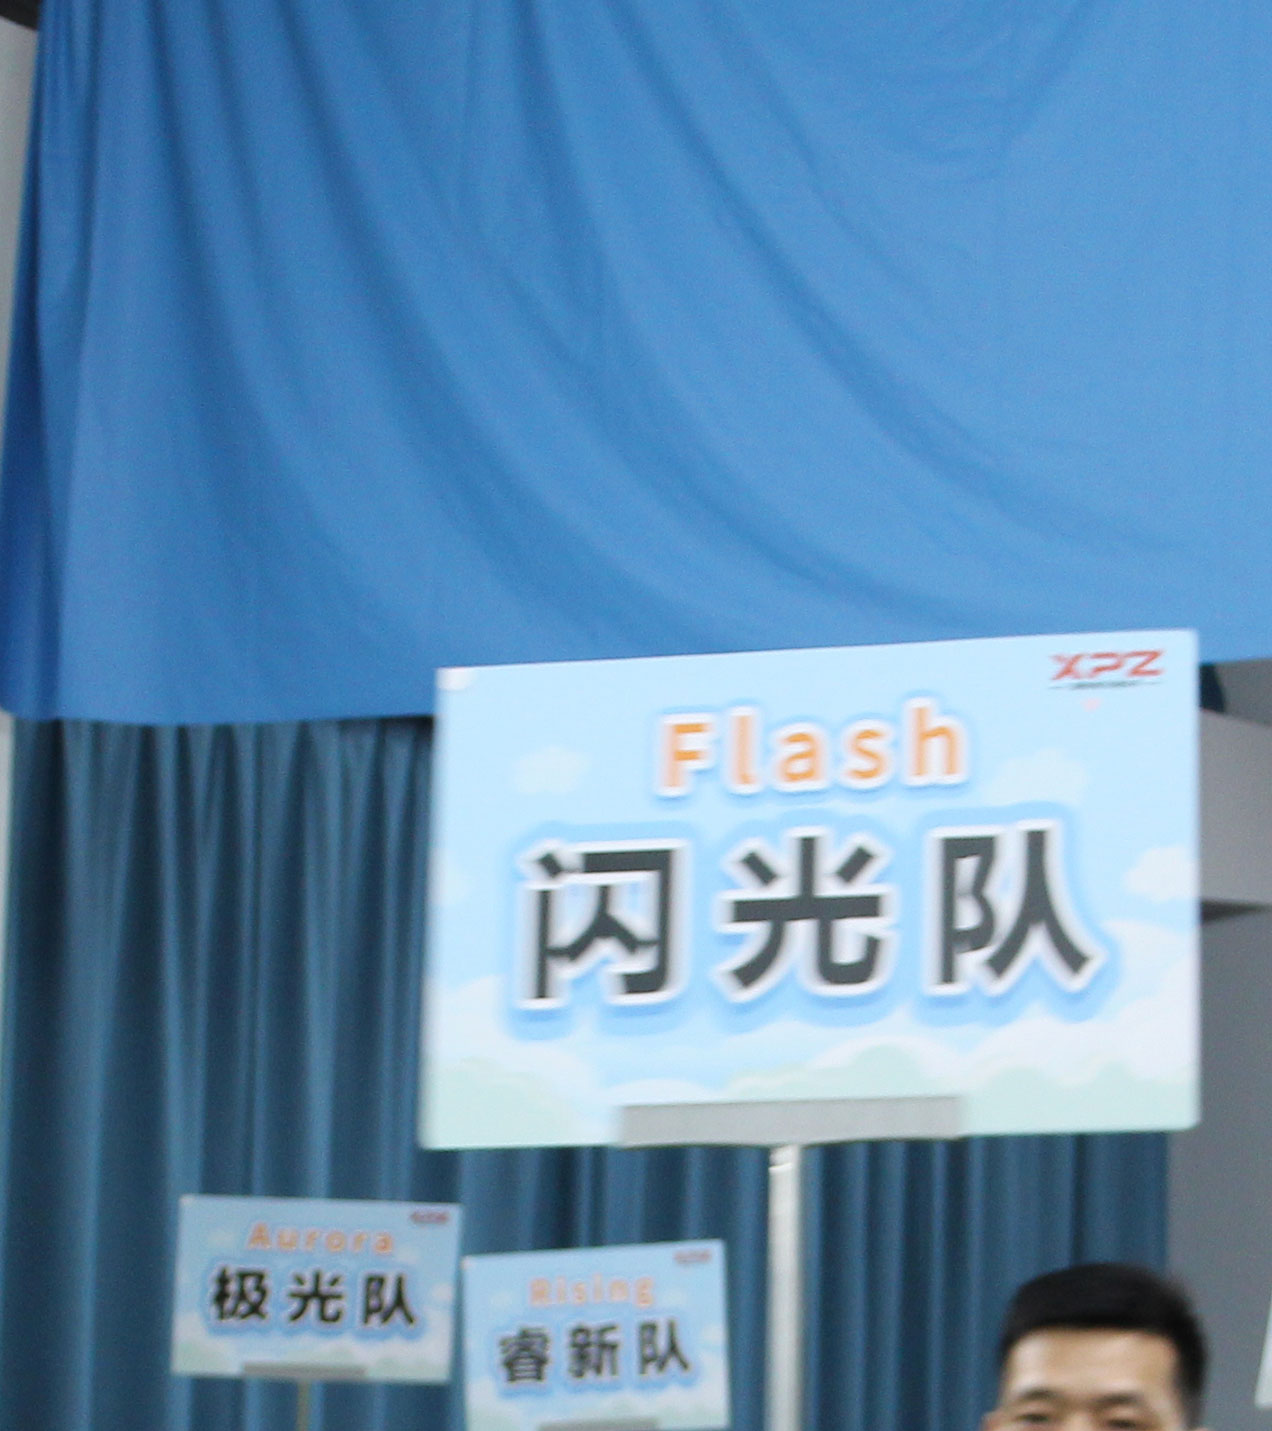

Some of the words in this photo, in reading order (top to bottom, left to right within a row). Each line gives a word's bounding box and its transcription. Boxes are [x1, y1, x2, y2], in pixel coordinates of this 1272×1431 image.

[1048, 650, 1165, 681] XPZ
[659, 701, 964, 792] Flash
[530, 828, 1096, 1001] 闪光队
[249, 1222, 394, 1254] Aurora
[214, 1267, 416, 1326] 极光队
[531, 1275, 654, 1308] Rising
[499, 1317, 691, 1383] 睿新队
